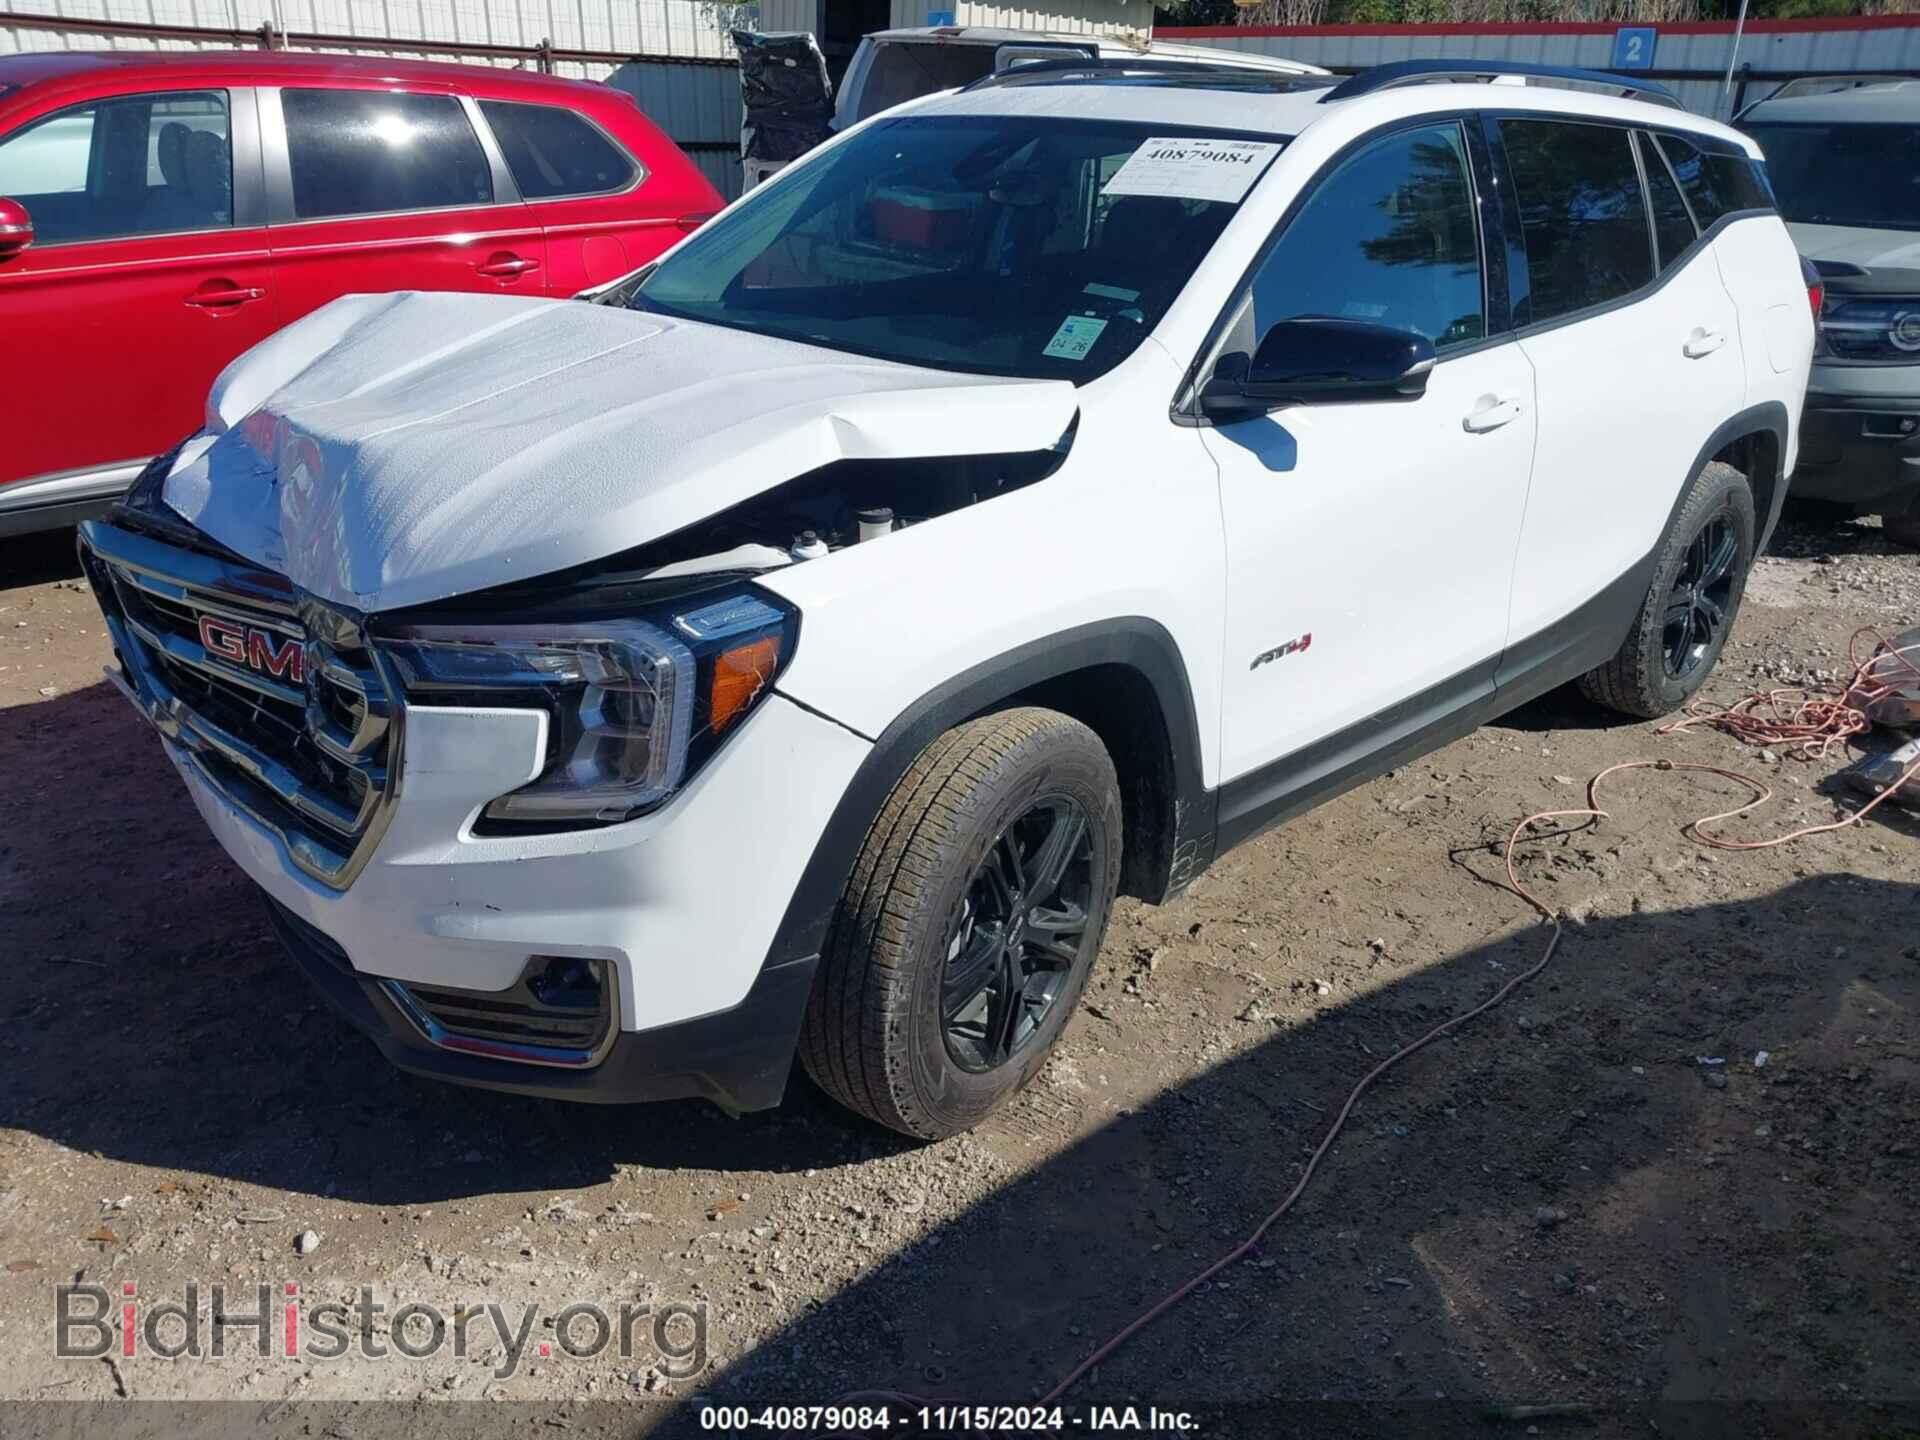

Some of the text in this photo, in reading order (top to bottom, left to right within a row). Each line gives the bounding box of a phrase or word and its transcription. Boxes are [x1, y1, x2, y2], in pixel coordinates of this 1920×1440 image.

[1625, 36, 1642, 61] 2
[1147, 149, 1254, 164] 40879084
[1072, 341, 1088, 352] 26
[199, 614, 306, 683] GM
[1249, 632, 1312, 671] AT4
